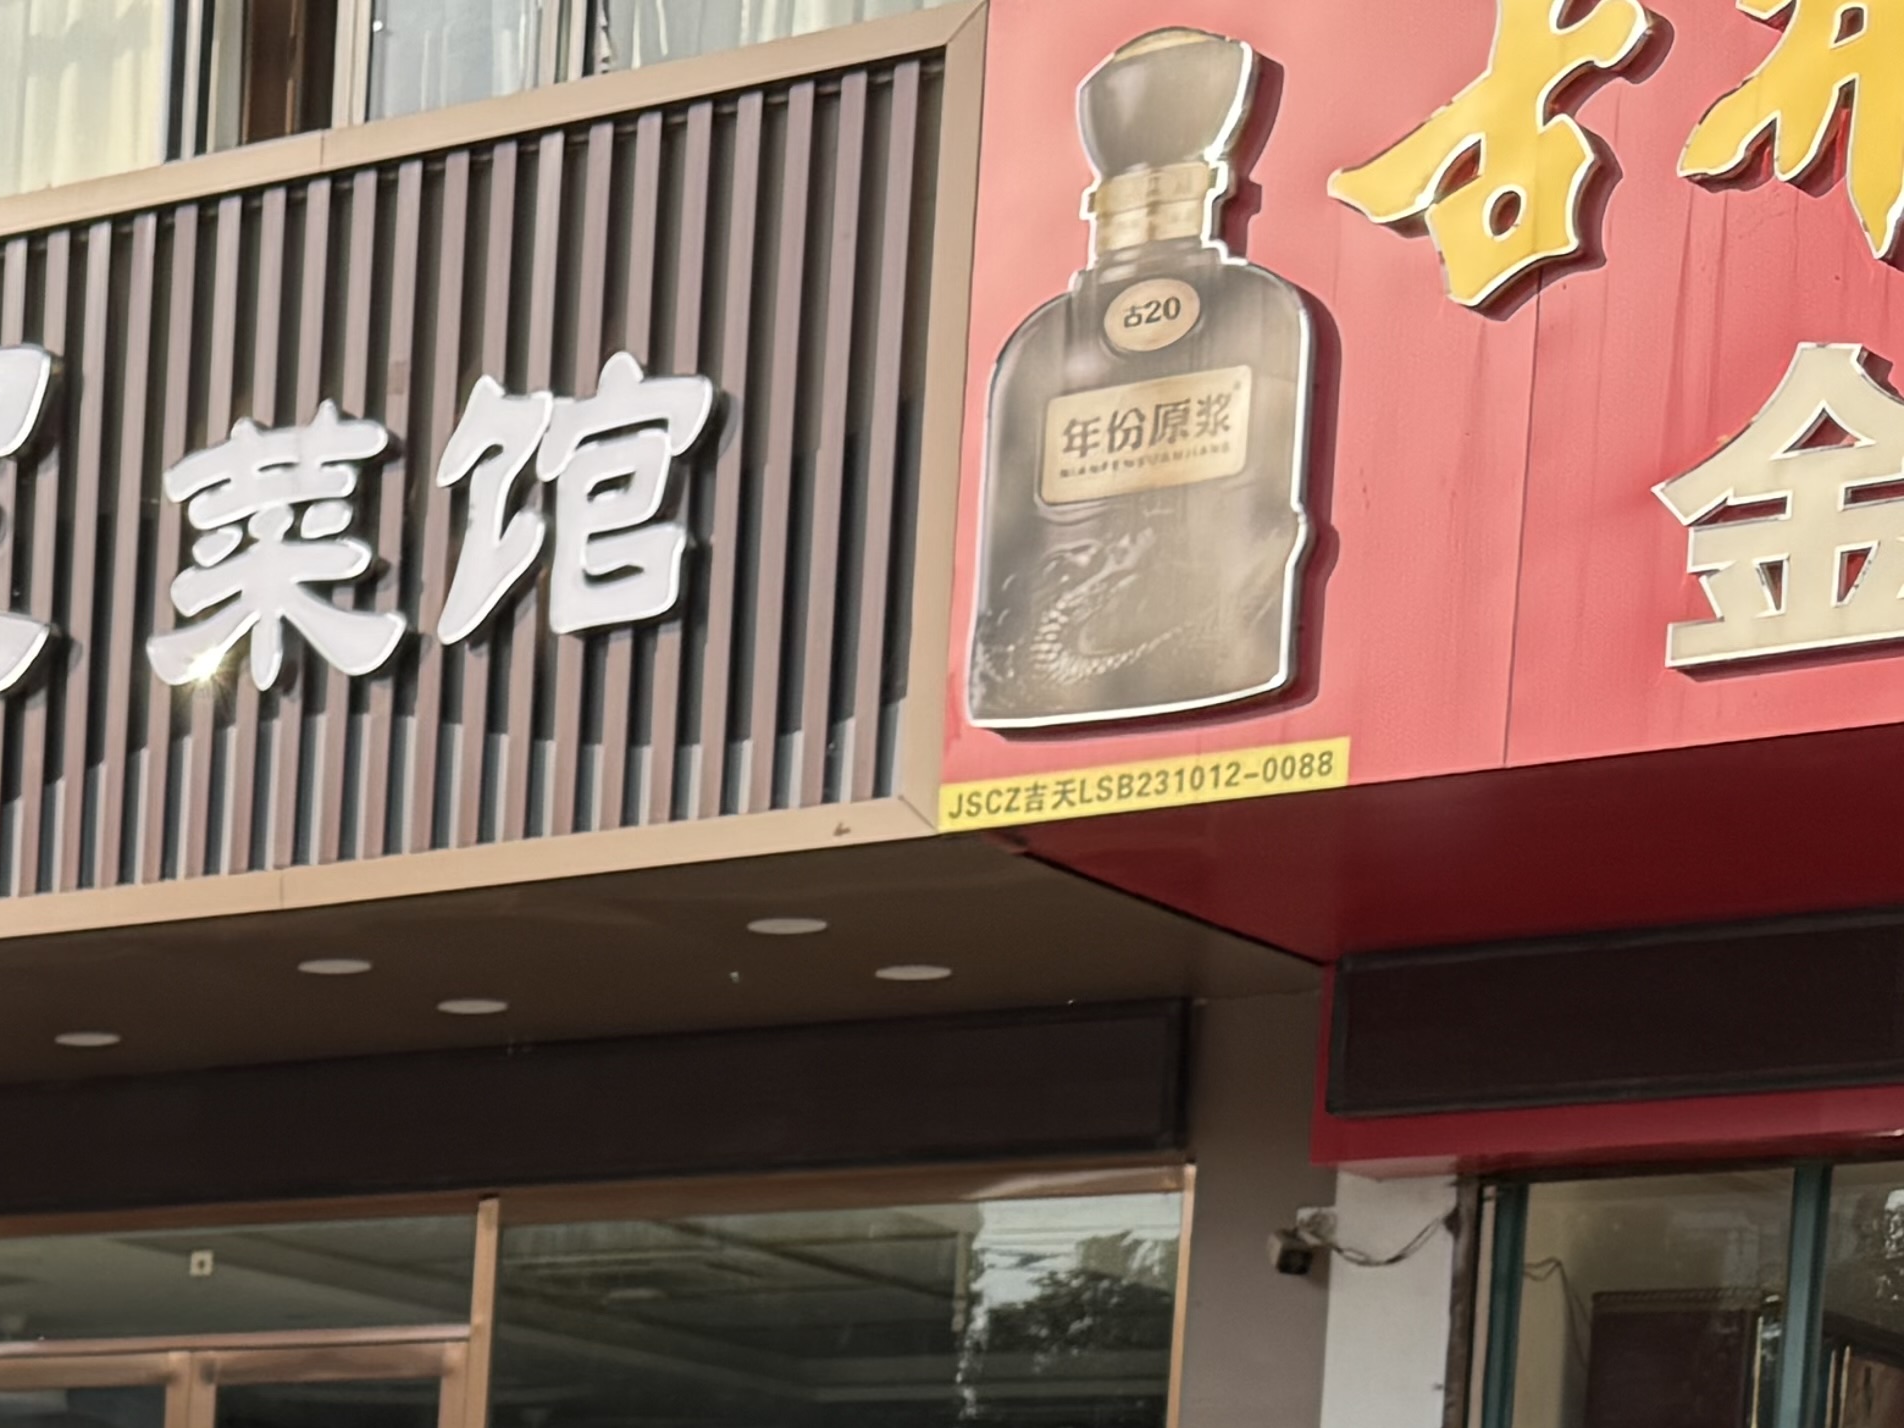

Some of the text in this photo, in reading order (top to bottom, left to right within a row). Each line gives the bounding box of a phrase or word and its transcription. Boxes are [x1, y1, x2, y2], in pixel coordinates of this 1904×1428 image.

[1122, 295, 1182, 329] 古20
[1060, 391, 1234, 460] 年份原浆
[1652, 341, 1904, 668] 金
